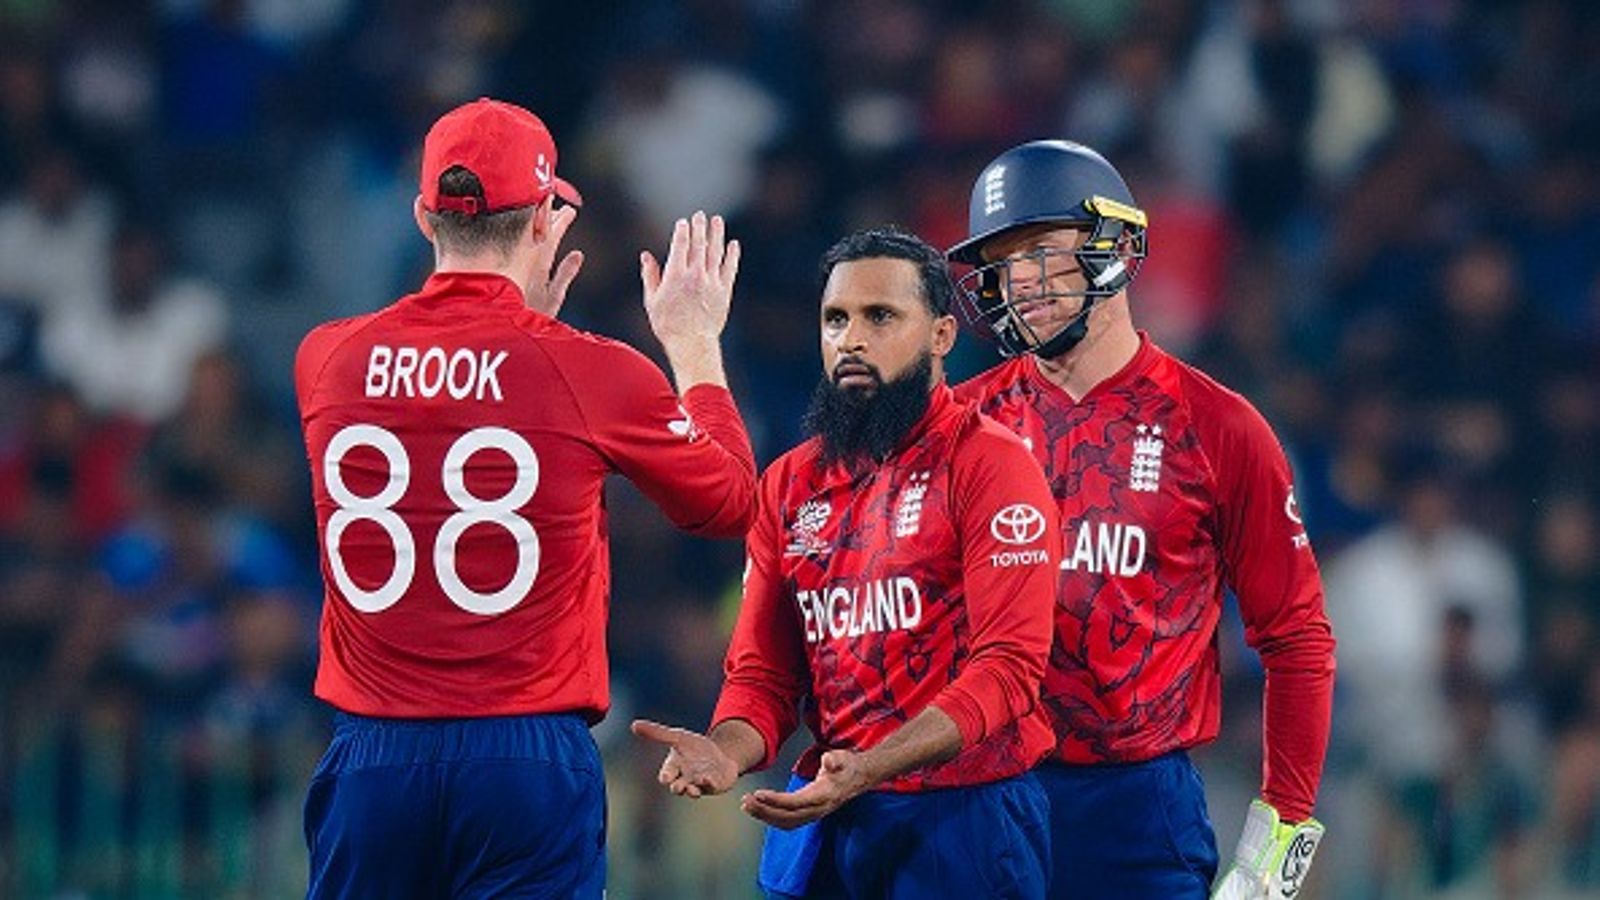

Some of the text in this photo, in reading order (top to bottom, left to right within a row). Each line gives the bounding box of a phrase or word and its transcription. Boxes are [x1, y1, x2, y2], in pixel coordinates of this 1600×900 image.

[365, 346, 508, 400] BROOK
[324, 424, 540, 615] 88
[990, 550, 1048, 567] TOYOTA
[797, 576, 922, 642] ENGLAND
